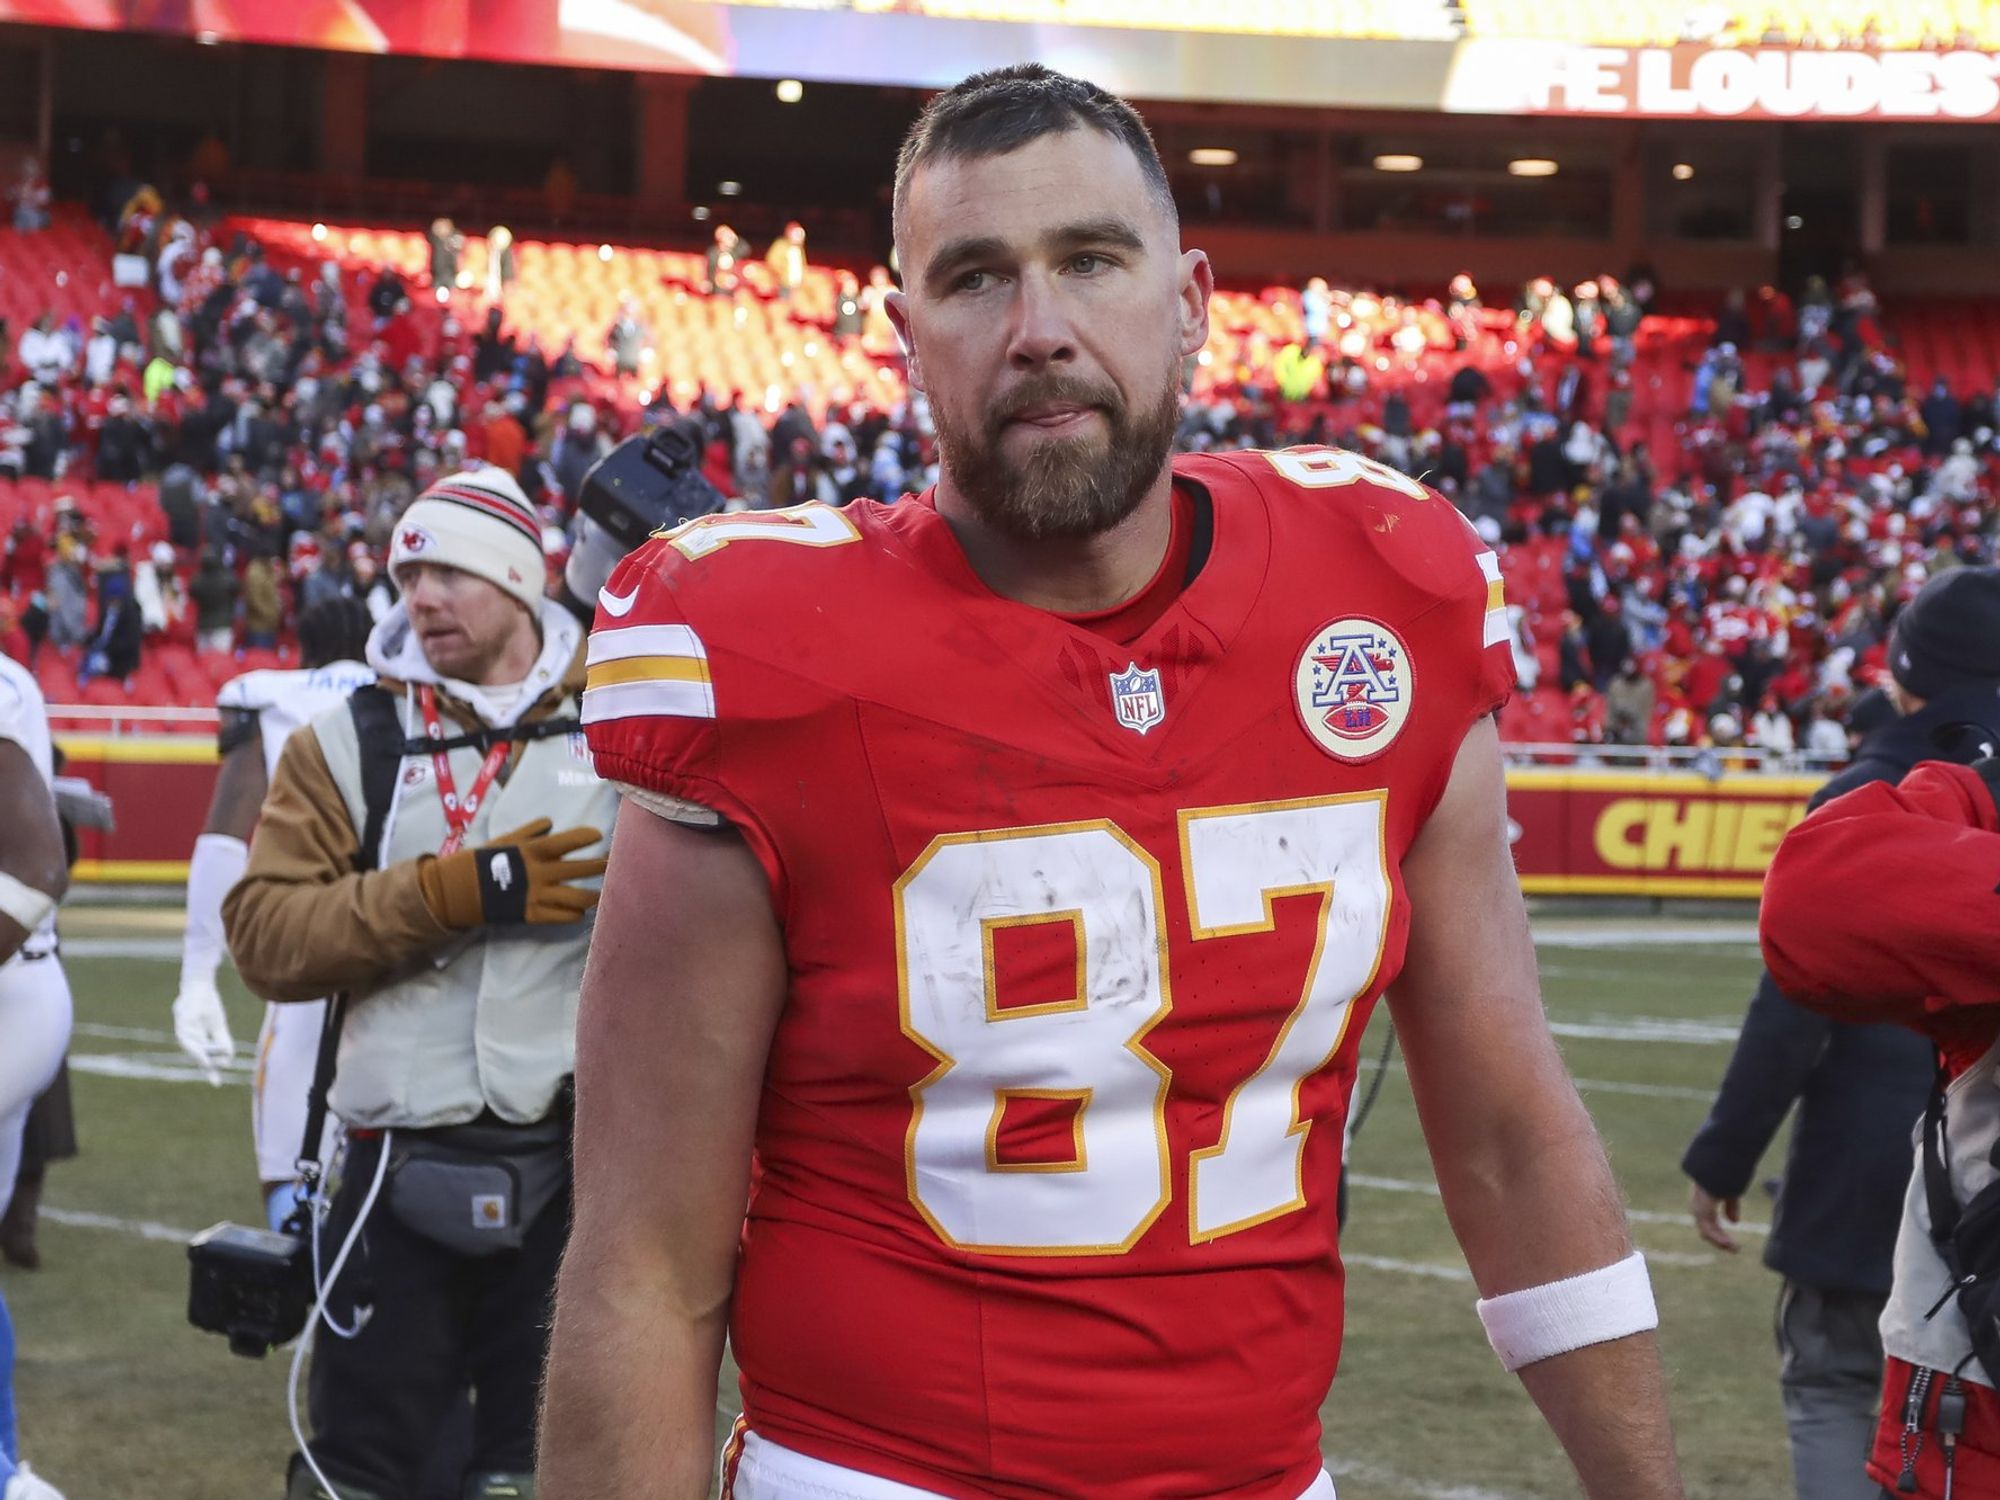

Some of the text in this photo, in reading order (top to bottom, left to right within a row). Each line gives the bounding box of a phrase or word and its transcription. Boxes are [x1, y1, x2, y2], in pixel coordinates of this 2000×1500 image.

[1500, 46, 2000, 117] HE LOUDES
[1121, 694, 1157, 721] NFL
[1594, 798, 1806, 872] CHIE
[892, 788, 1392, 1256] 87
